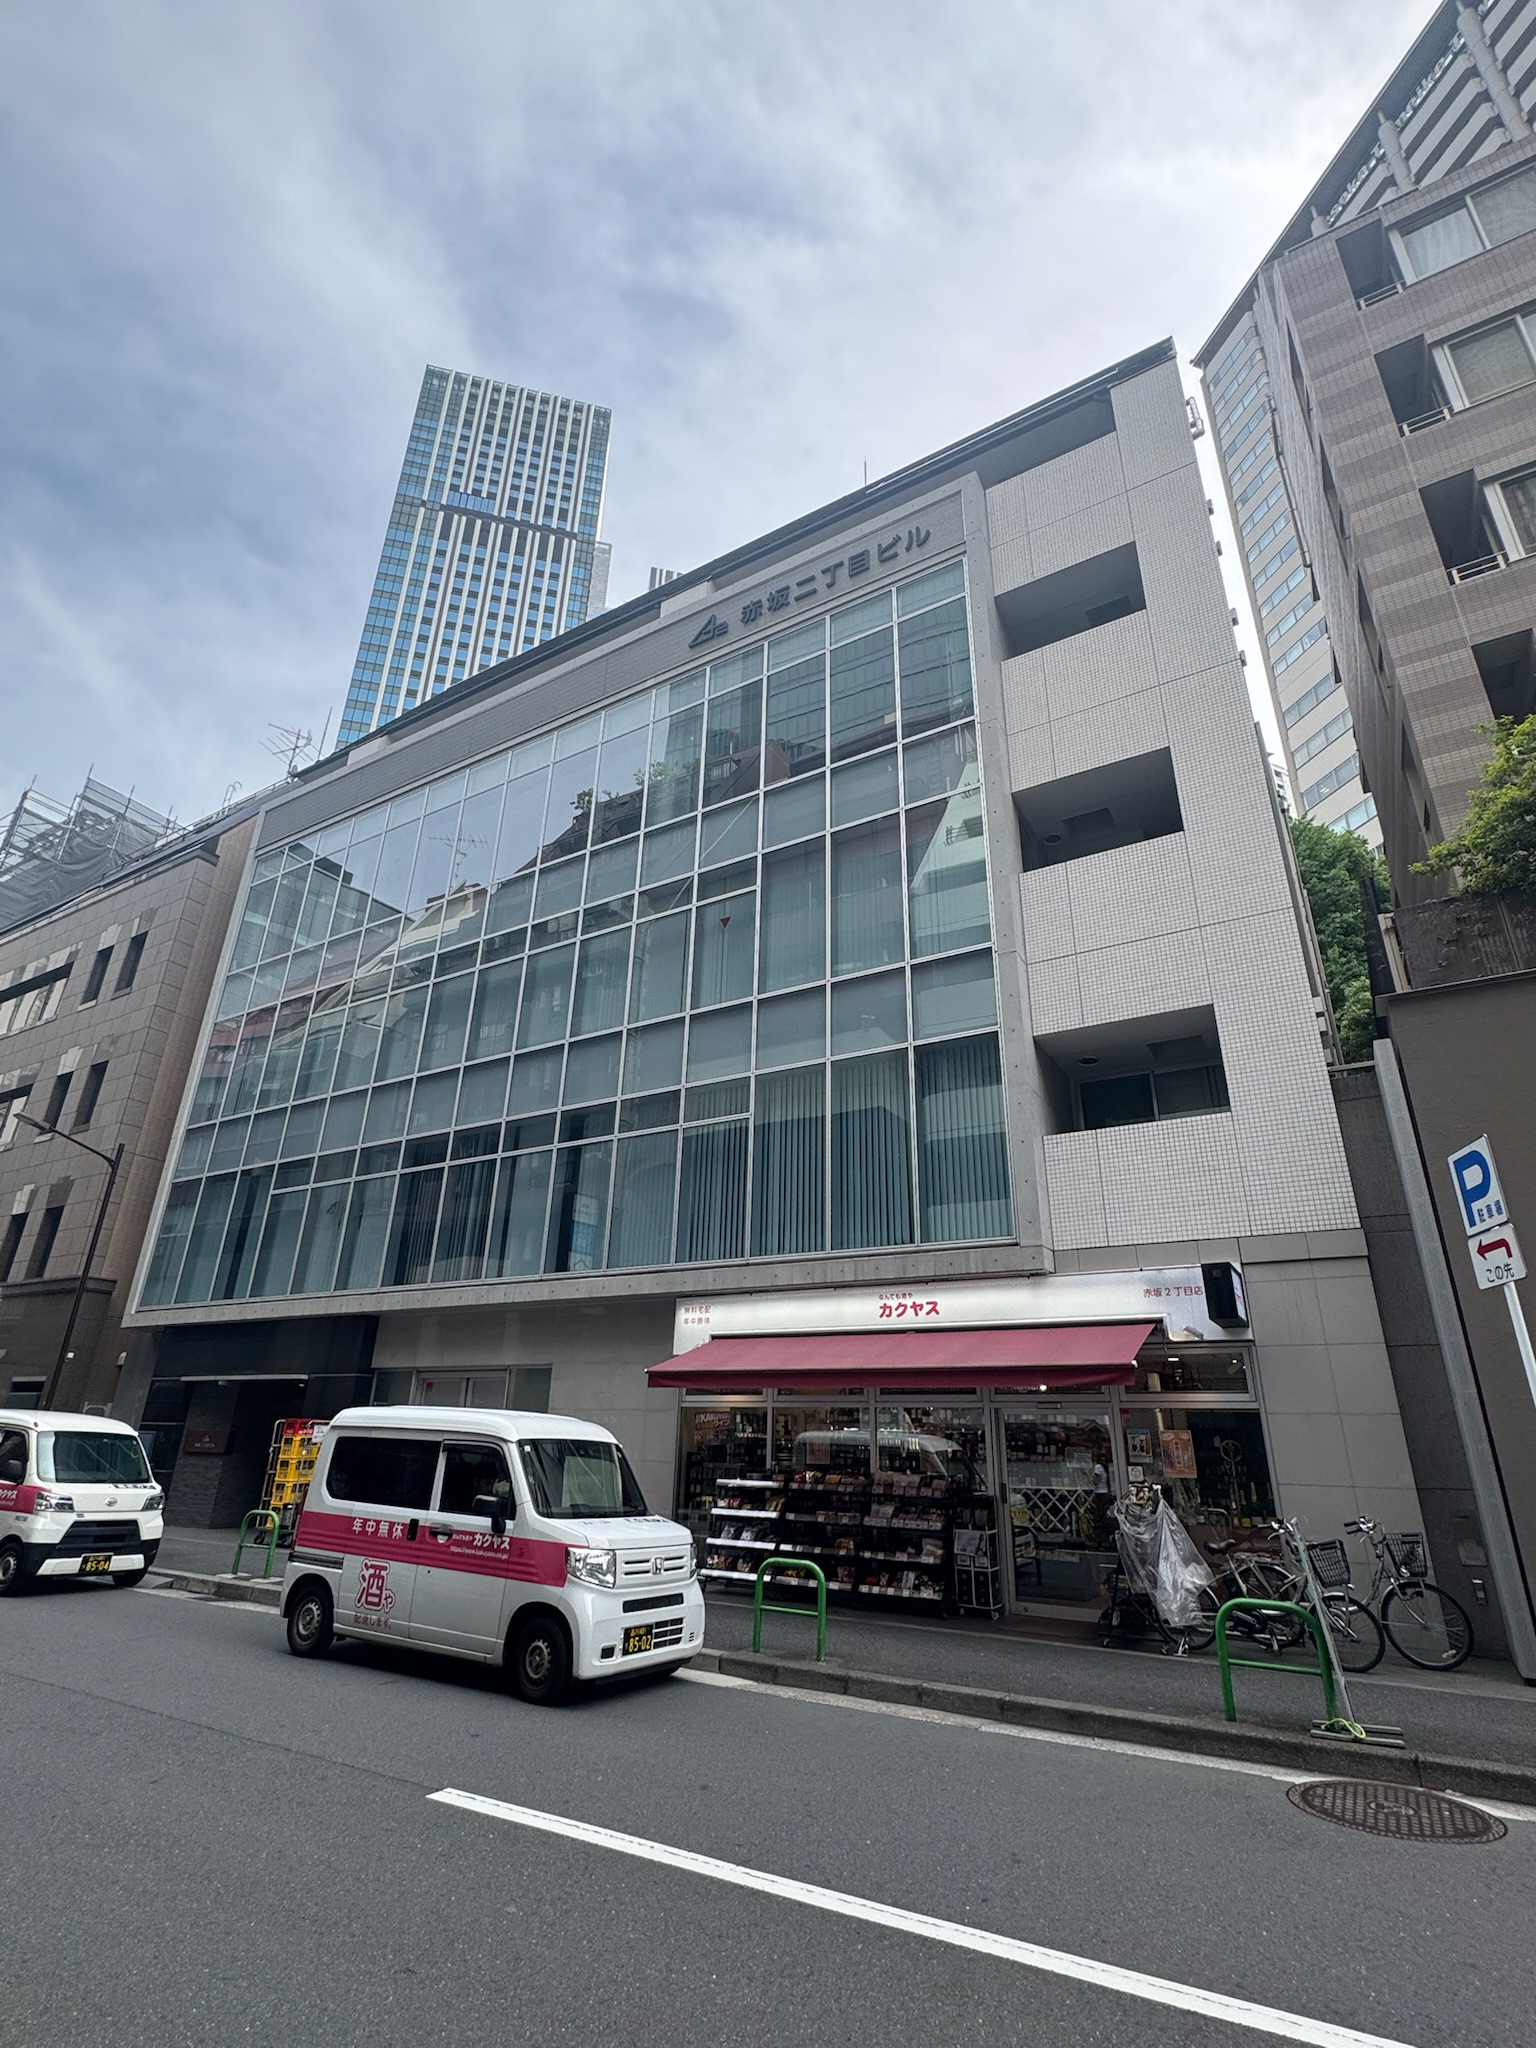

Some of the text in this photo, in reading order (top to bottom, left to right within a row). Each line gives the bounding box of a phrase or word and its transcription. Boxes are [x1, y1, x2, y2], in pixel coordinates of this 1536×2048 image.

[741, 526, 930, 623] 赤坂二丁目ビル
[1486, 1262, 1515, 1283] この先
[1143, 1285, 1204, 1298] 赤坂2丁目店
[879, 1301, 940, 1319] カクヤス
[352, 1517, 404, 1540] 年中無休
[473, 1532, 511, 1550] カクヤス
[628, 1634, 652, 1653] 85-02
